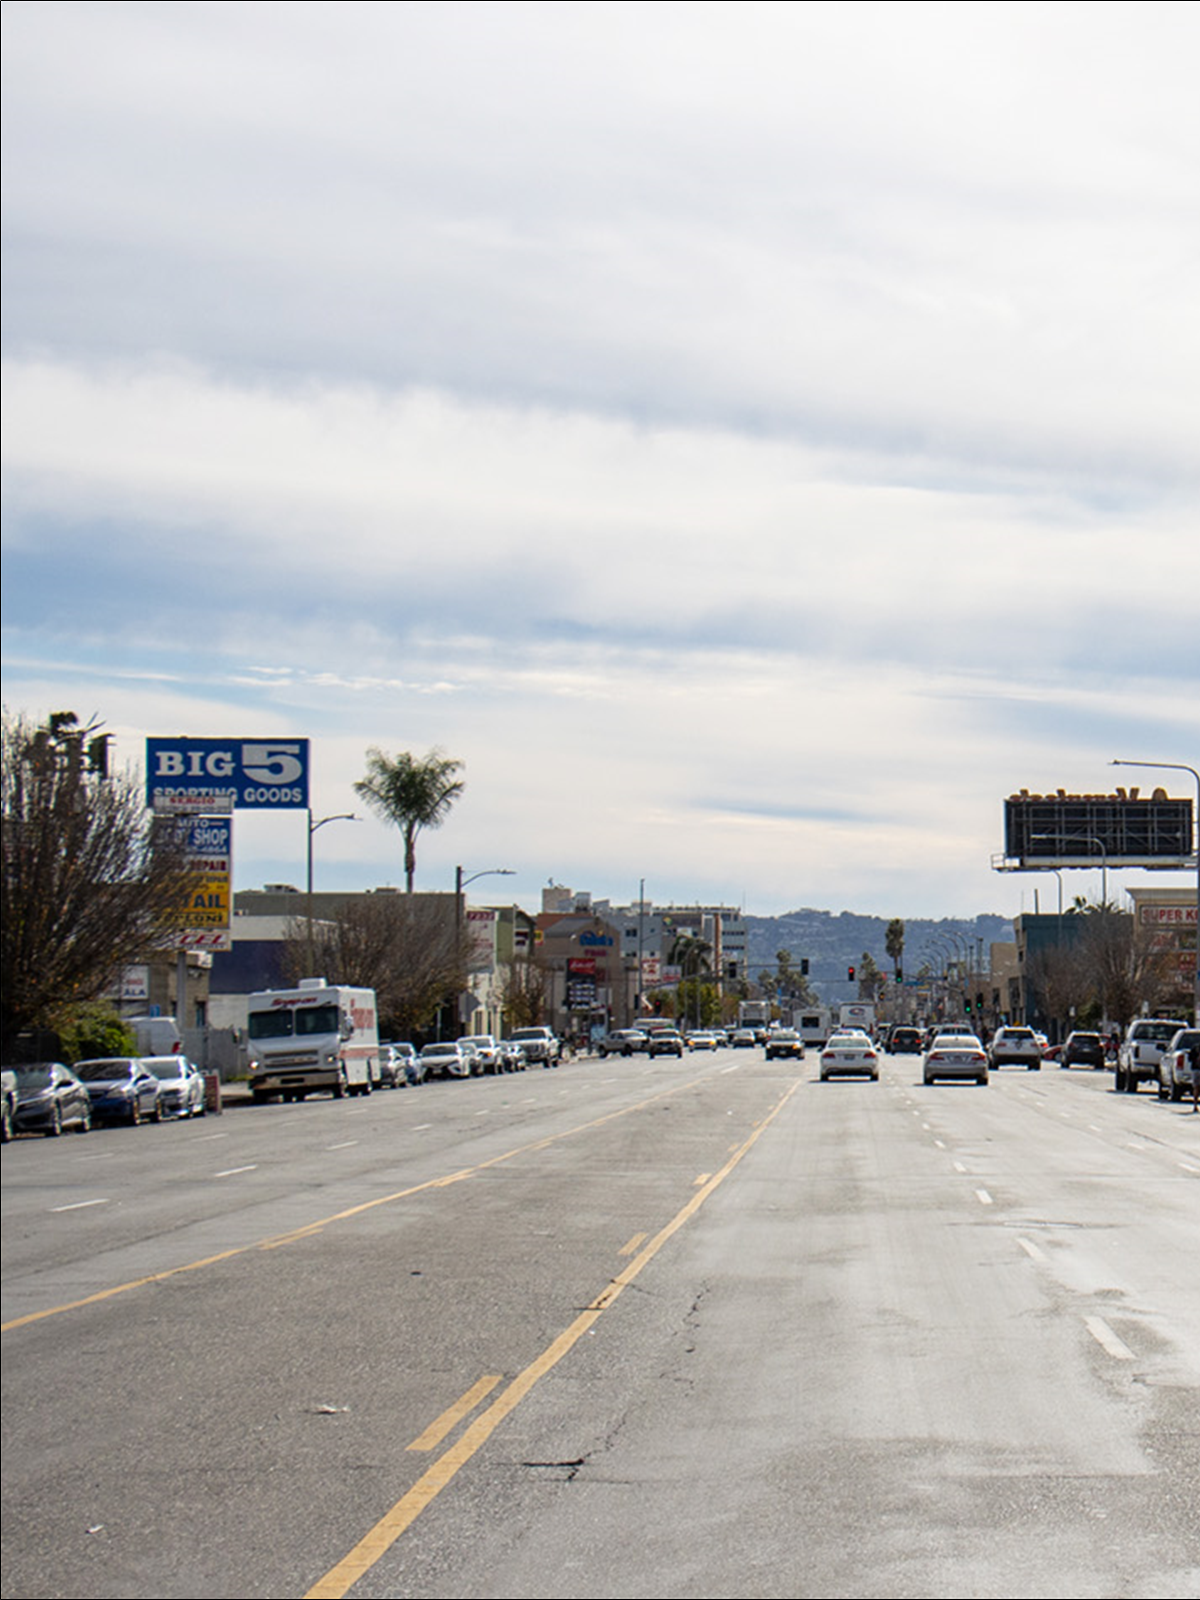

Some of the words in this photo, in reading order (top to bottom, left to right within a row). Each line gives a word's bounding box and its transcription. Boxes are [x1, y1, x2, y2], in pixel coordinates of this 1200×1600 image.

[155, 751, 236, 777] BIG
[242, 744, 303, 785] 5
[244, 788, 303, 803] GOODS
[194, 829, 229, 845] SHOP
